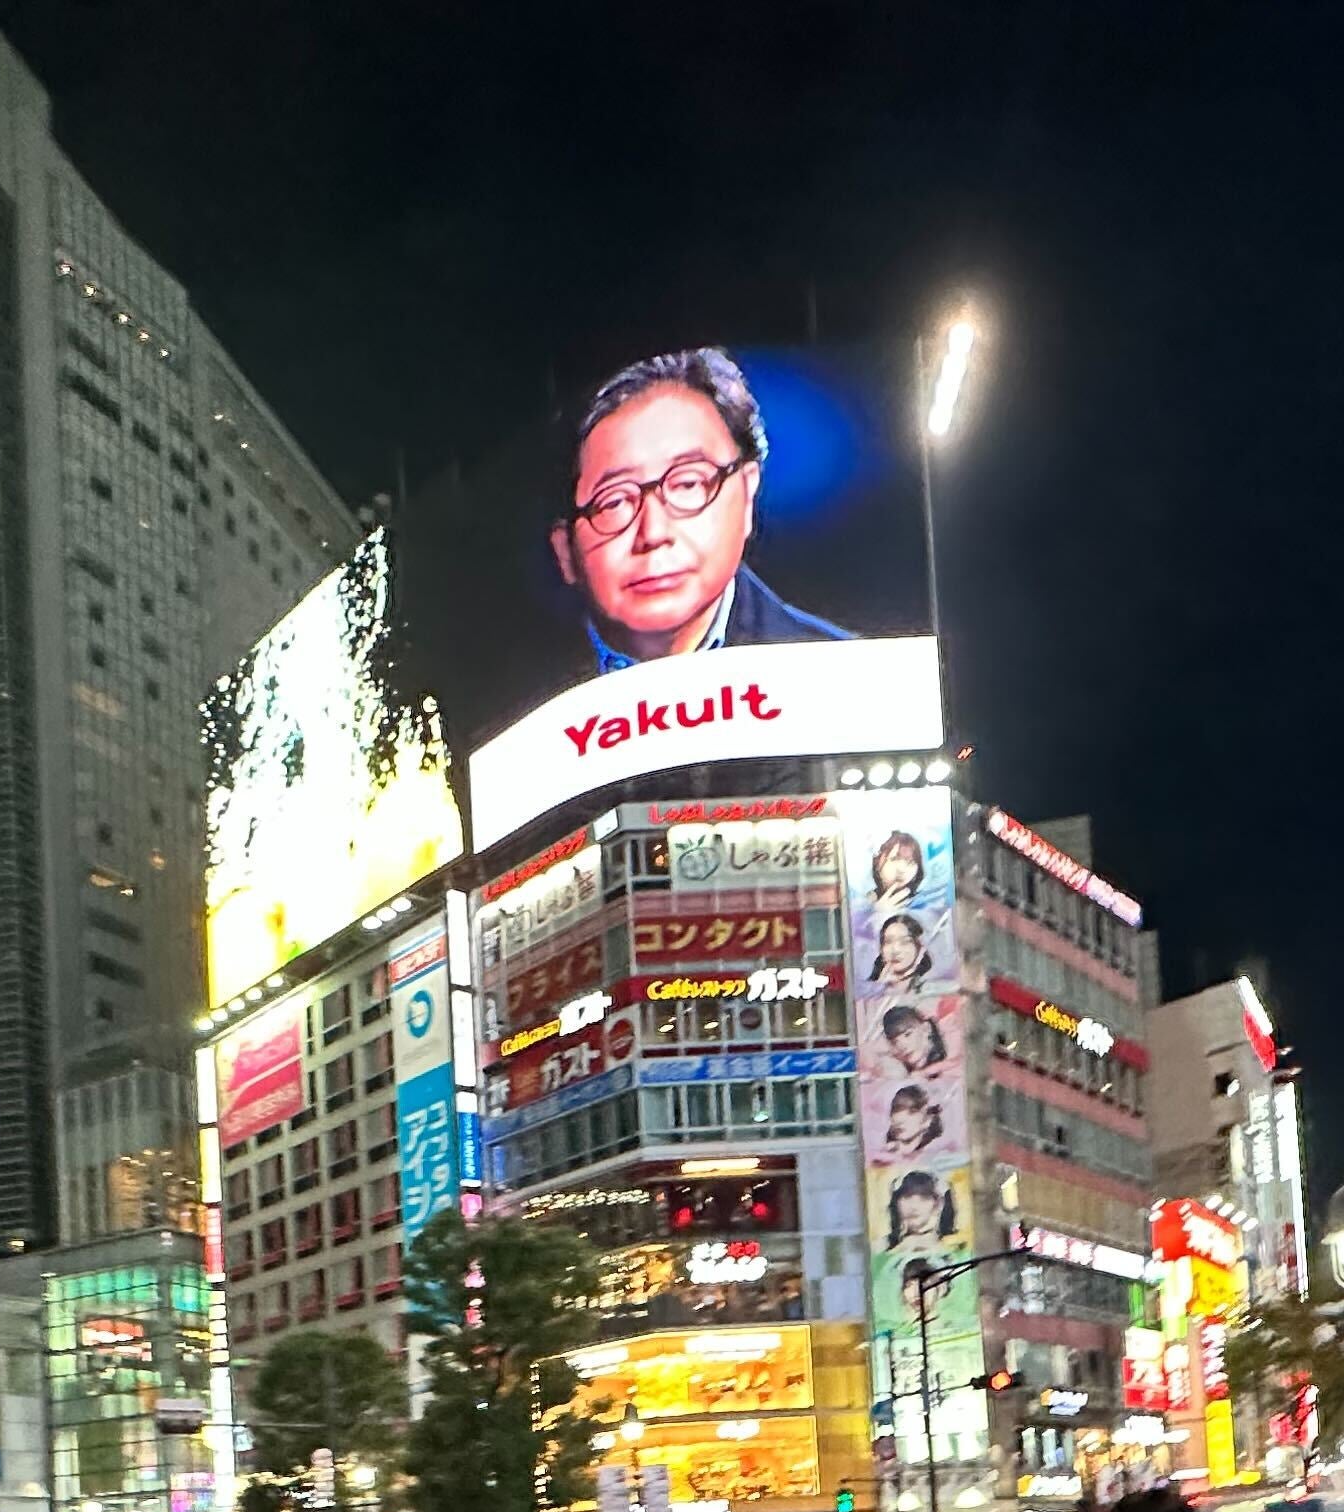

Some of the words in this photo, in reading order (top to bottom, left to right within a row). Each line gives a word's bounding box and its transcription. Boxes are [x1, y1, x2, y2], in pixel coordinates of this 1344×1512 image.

[564, 683, 782, 757] Yakult
[635, 914, 798, 953] コンタクト
[746, 966, 830, 1002] ガスト
